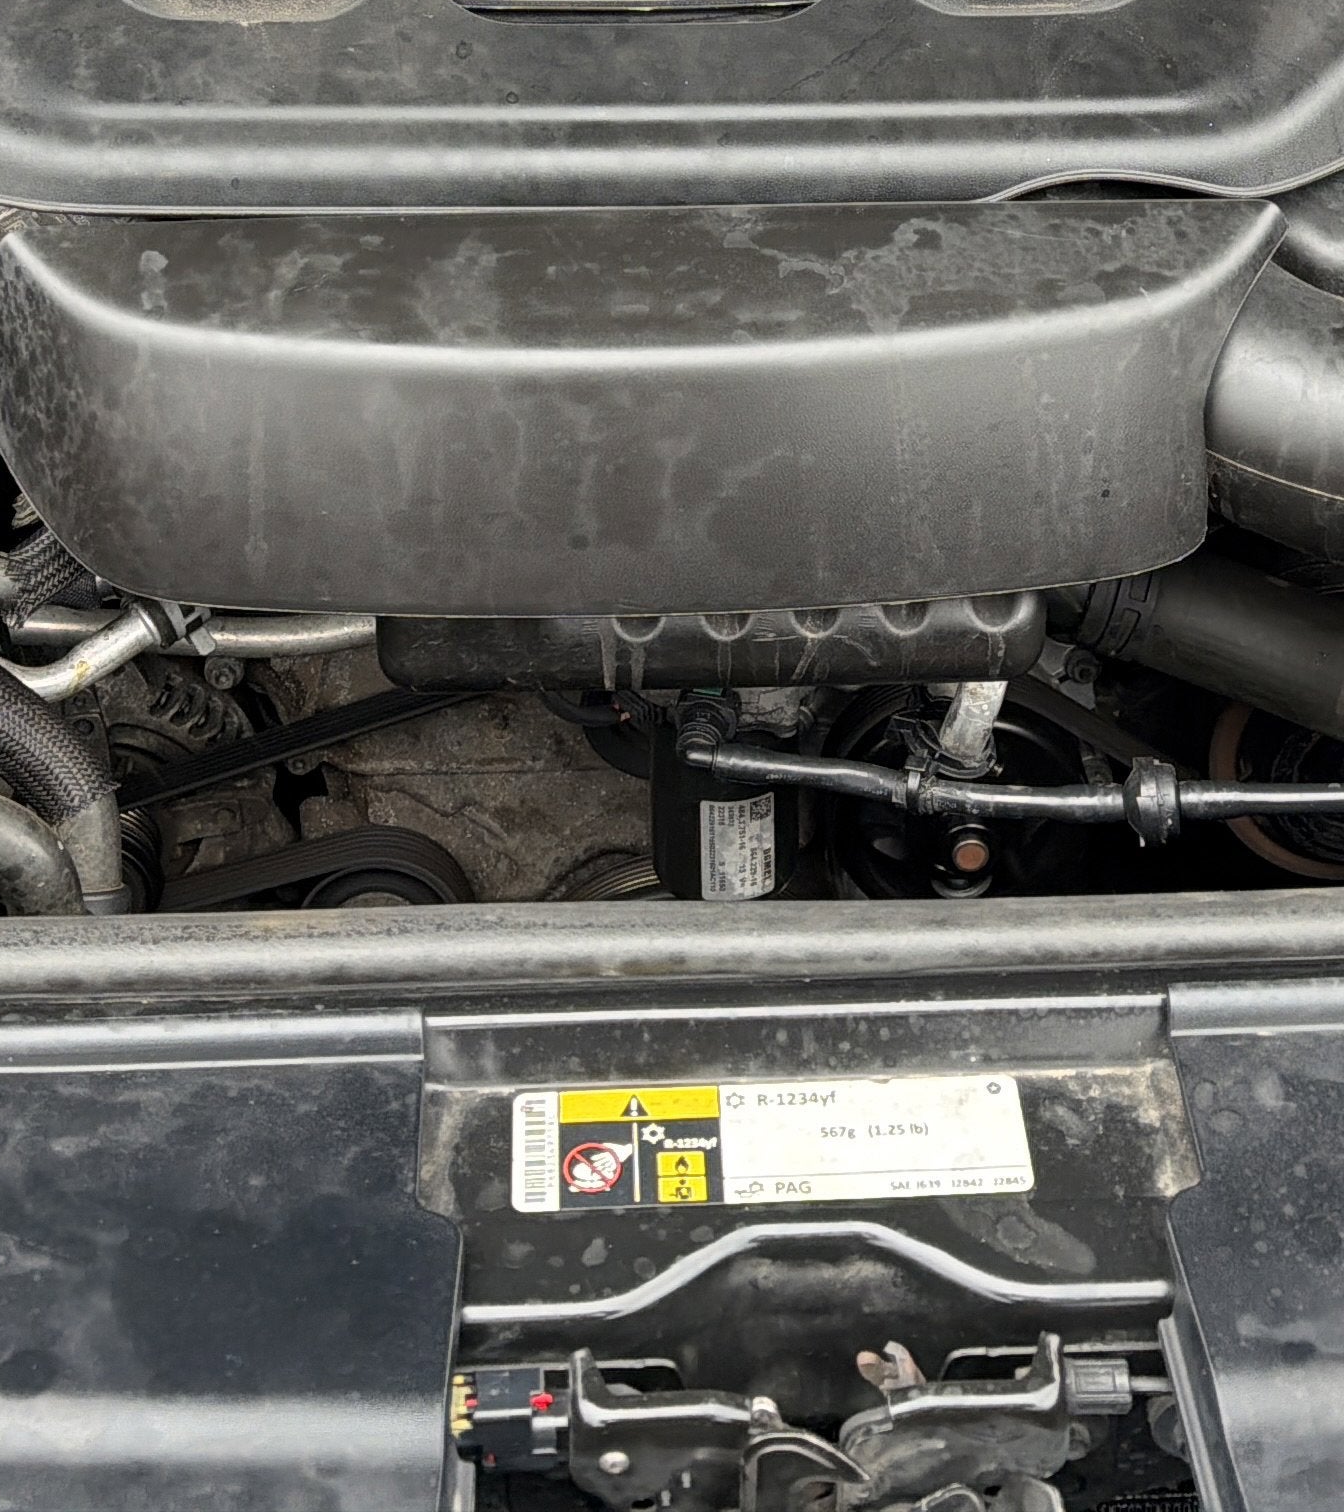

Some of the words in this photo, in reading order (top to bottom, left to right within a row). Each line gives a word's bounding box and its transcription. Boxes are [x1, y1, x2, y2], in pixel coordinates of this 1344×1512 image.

[757, 1090, 836, 1107] R-1234yf
[820, 1126, 856, 1140] 567g
[868, 1123, 906, 1138] (1.25
[909, 1122, 929, 1136] lb)
[774, 1180, 812, 1195] PAG
